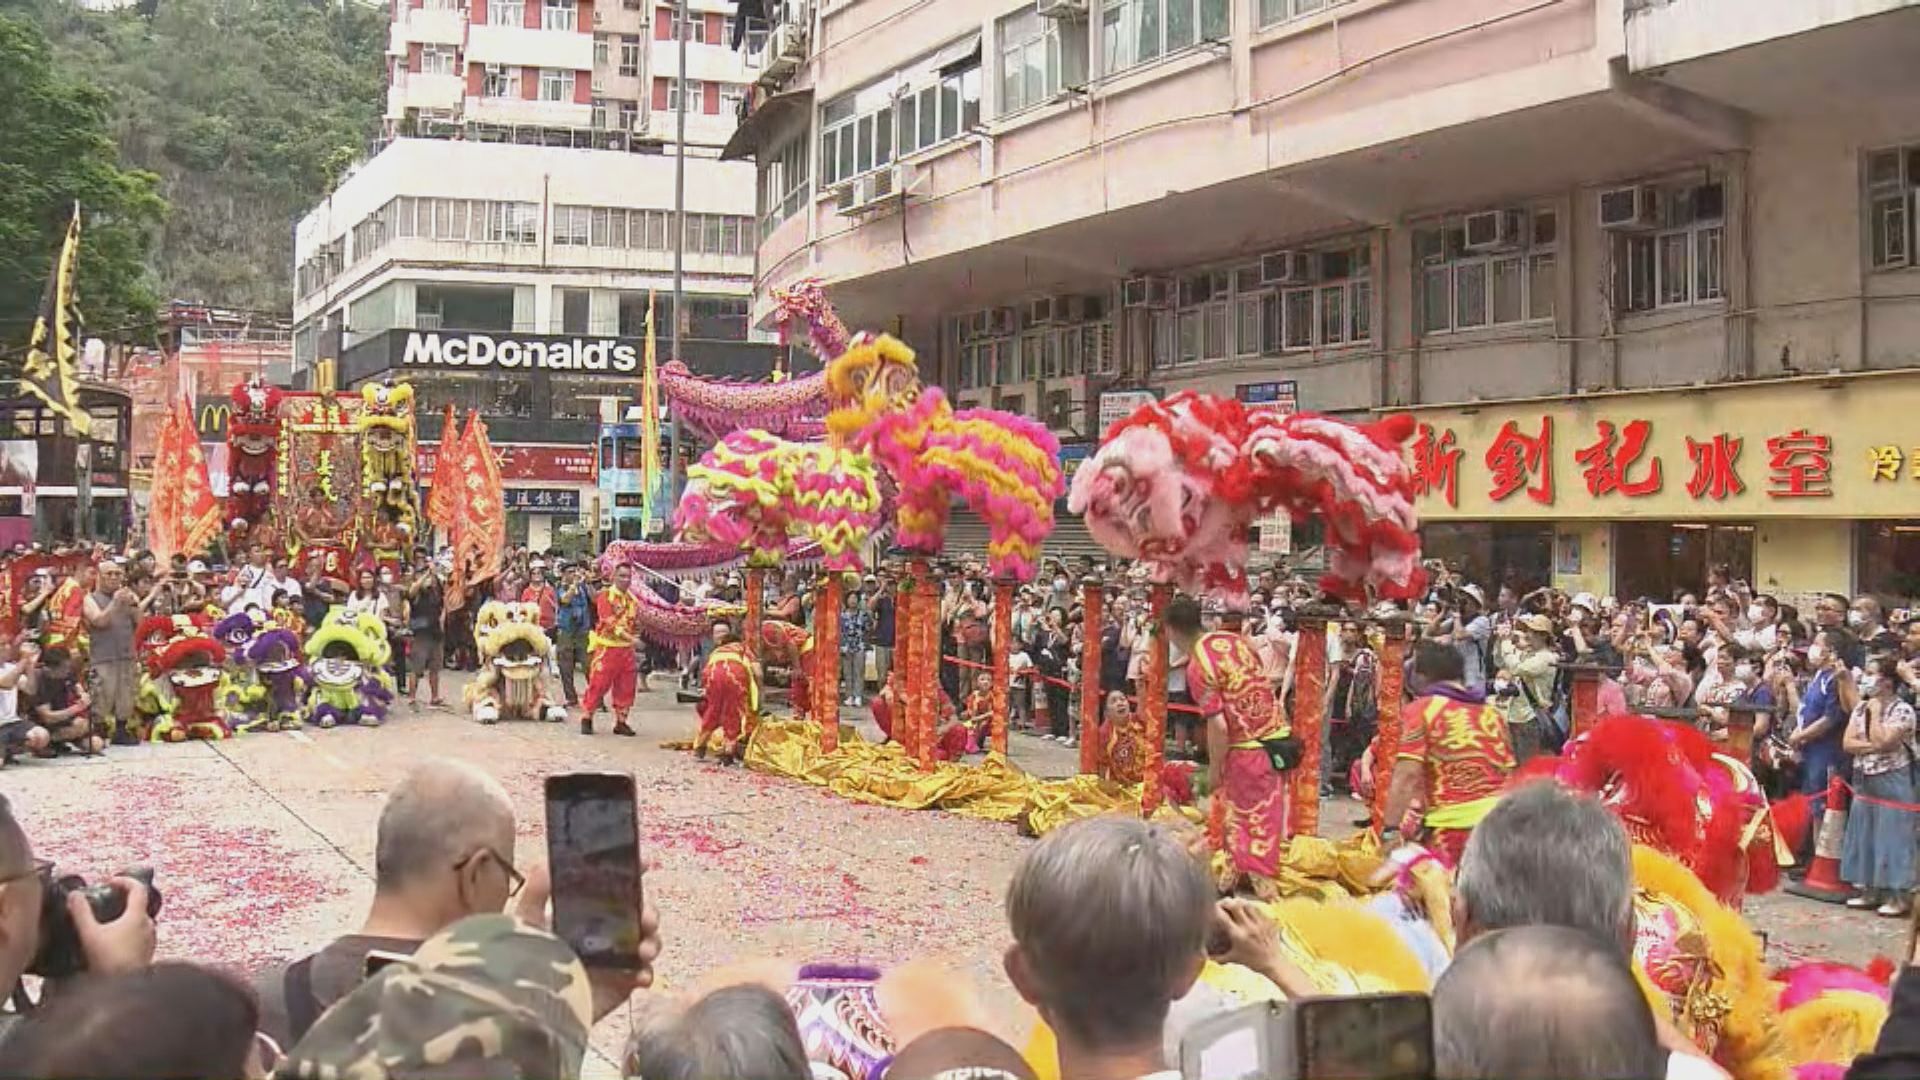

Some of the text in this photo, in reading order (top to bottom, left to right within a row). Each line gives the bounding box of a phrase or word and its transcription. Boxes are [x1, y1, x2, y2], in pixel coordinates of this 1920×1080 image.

[403, 332, 637, 371] McDonald's
[1412, 415, 1832, 507] 新釗記冰室
[1865, 445, 1920, 481] 冷
